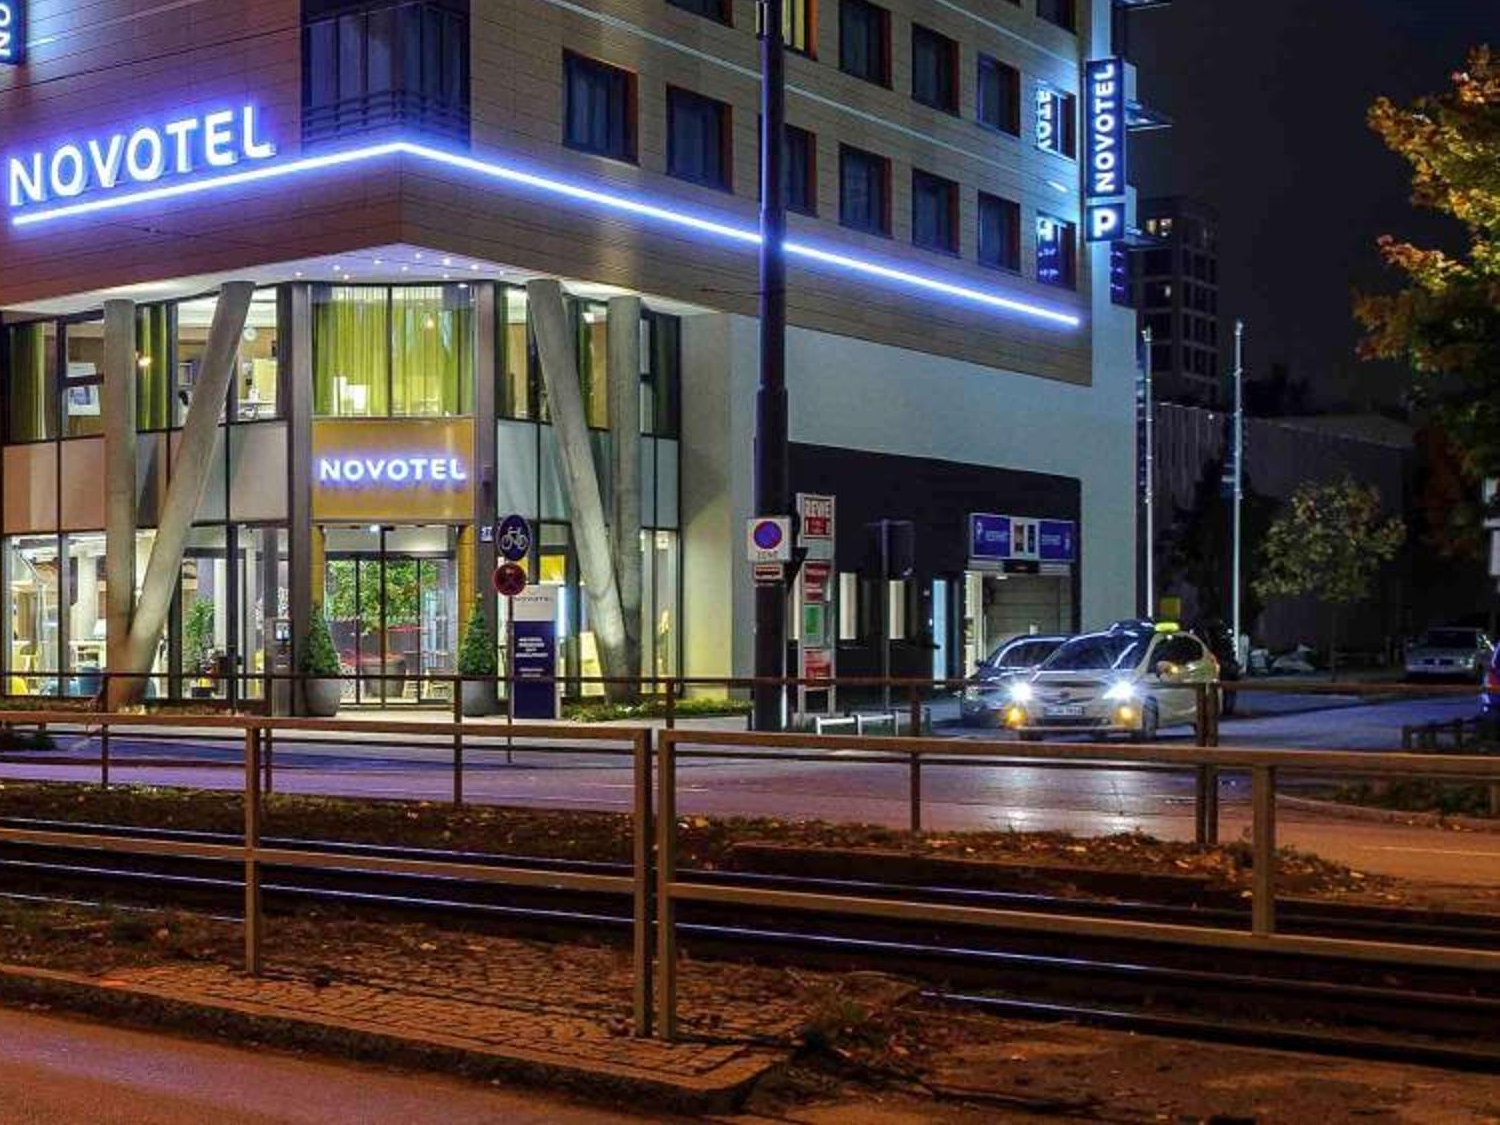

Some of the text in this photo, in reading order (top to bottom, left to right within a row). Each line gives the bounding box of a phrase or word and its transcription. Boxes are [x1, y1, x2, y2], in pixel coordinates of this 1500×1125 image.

[8, 105, 277, 206] NOVOTEL
[1094, 63, 1117, 194] NOVOTEL
[1092, 206, 1118, 239] P
[319, 457, 467, 482] NOVOTEL
